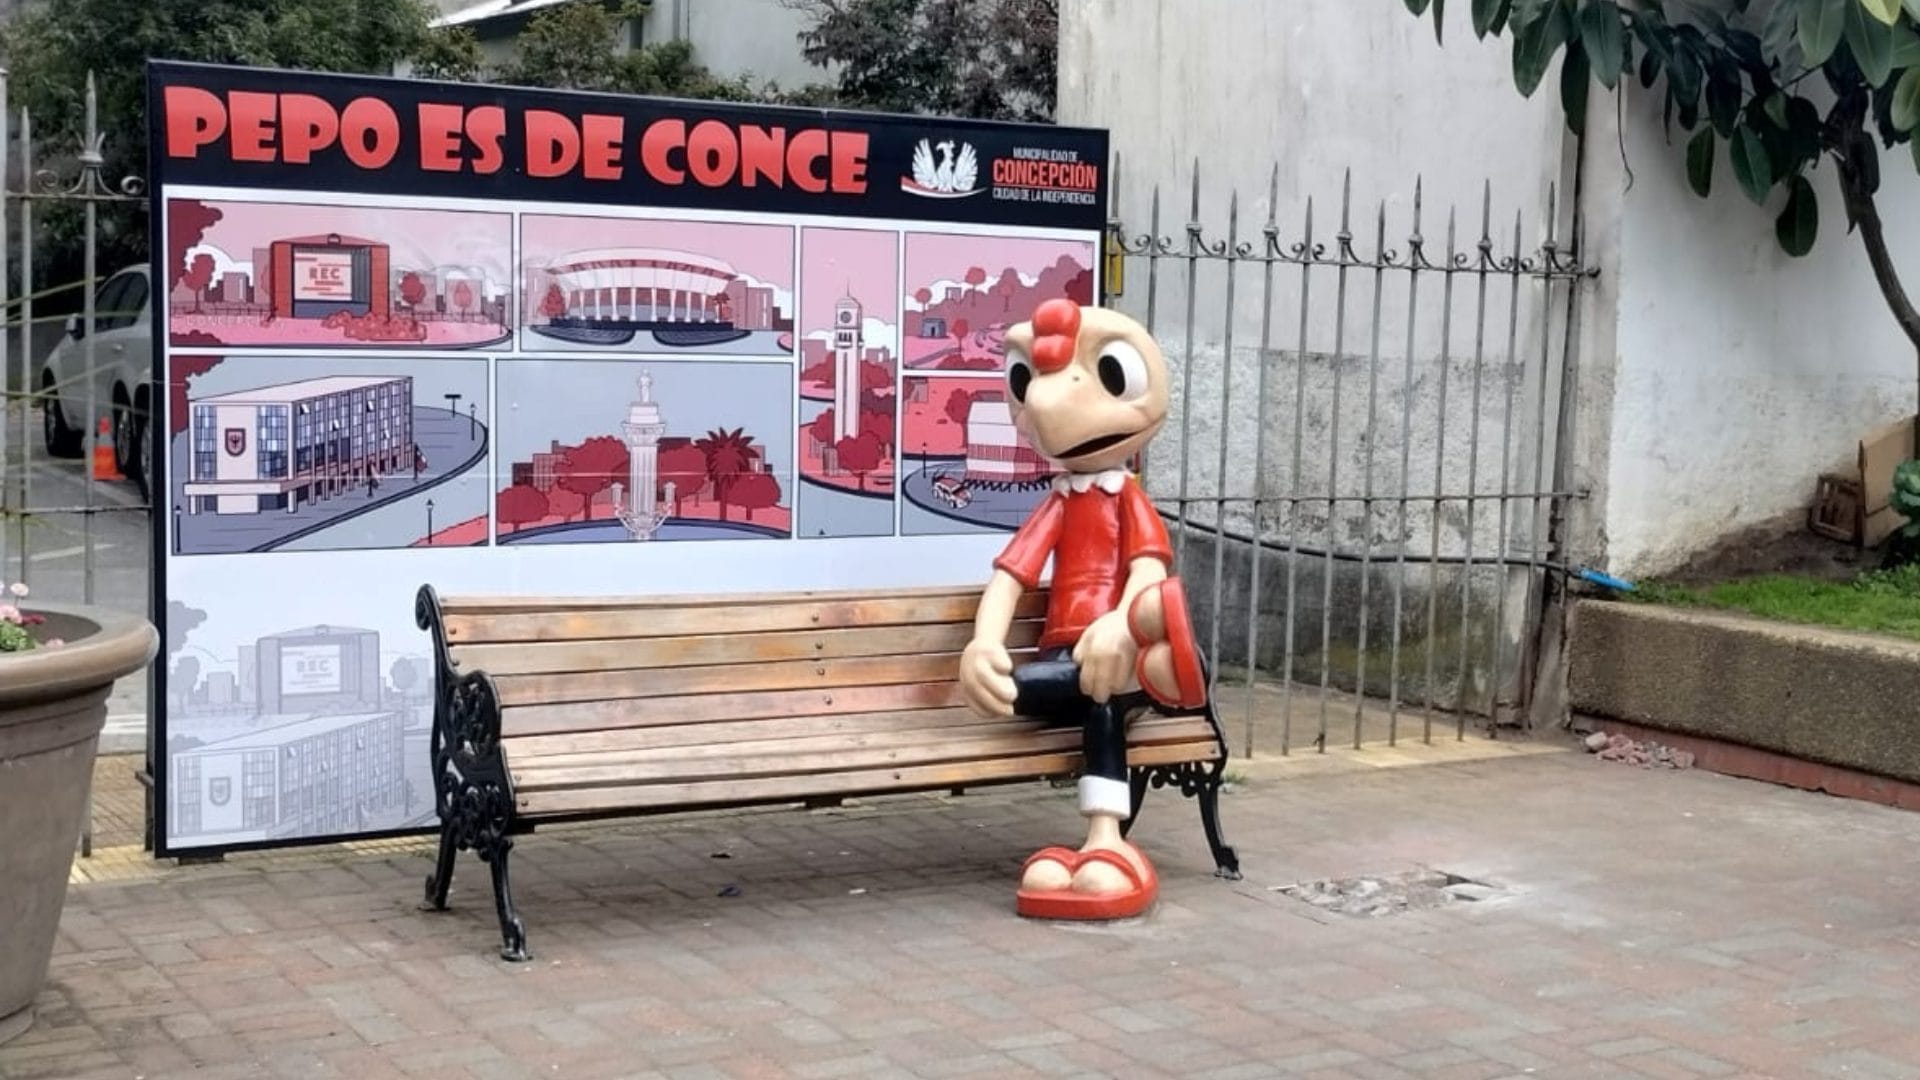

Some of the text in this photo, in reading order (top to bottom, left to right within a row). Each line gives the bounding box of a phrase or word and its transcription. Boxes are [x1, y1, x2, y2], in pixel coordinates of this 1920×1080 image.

[164, 86, 869, 194] PEPO ES DE CONCE
[993, 159, 1097, 187] CONCEPCIÓN
[309, 268, 341, 280] REC
